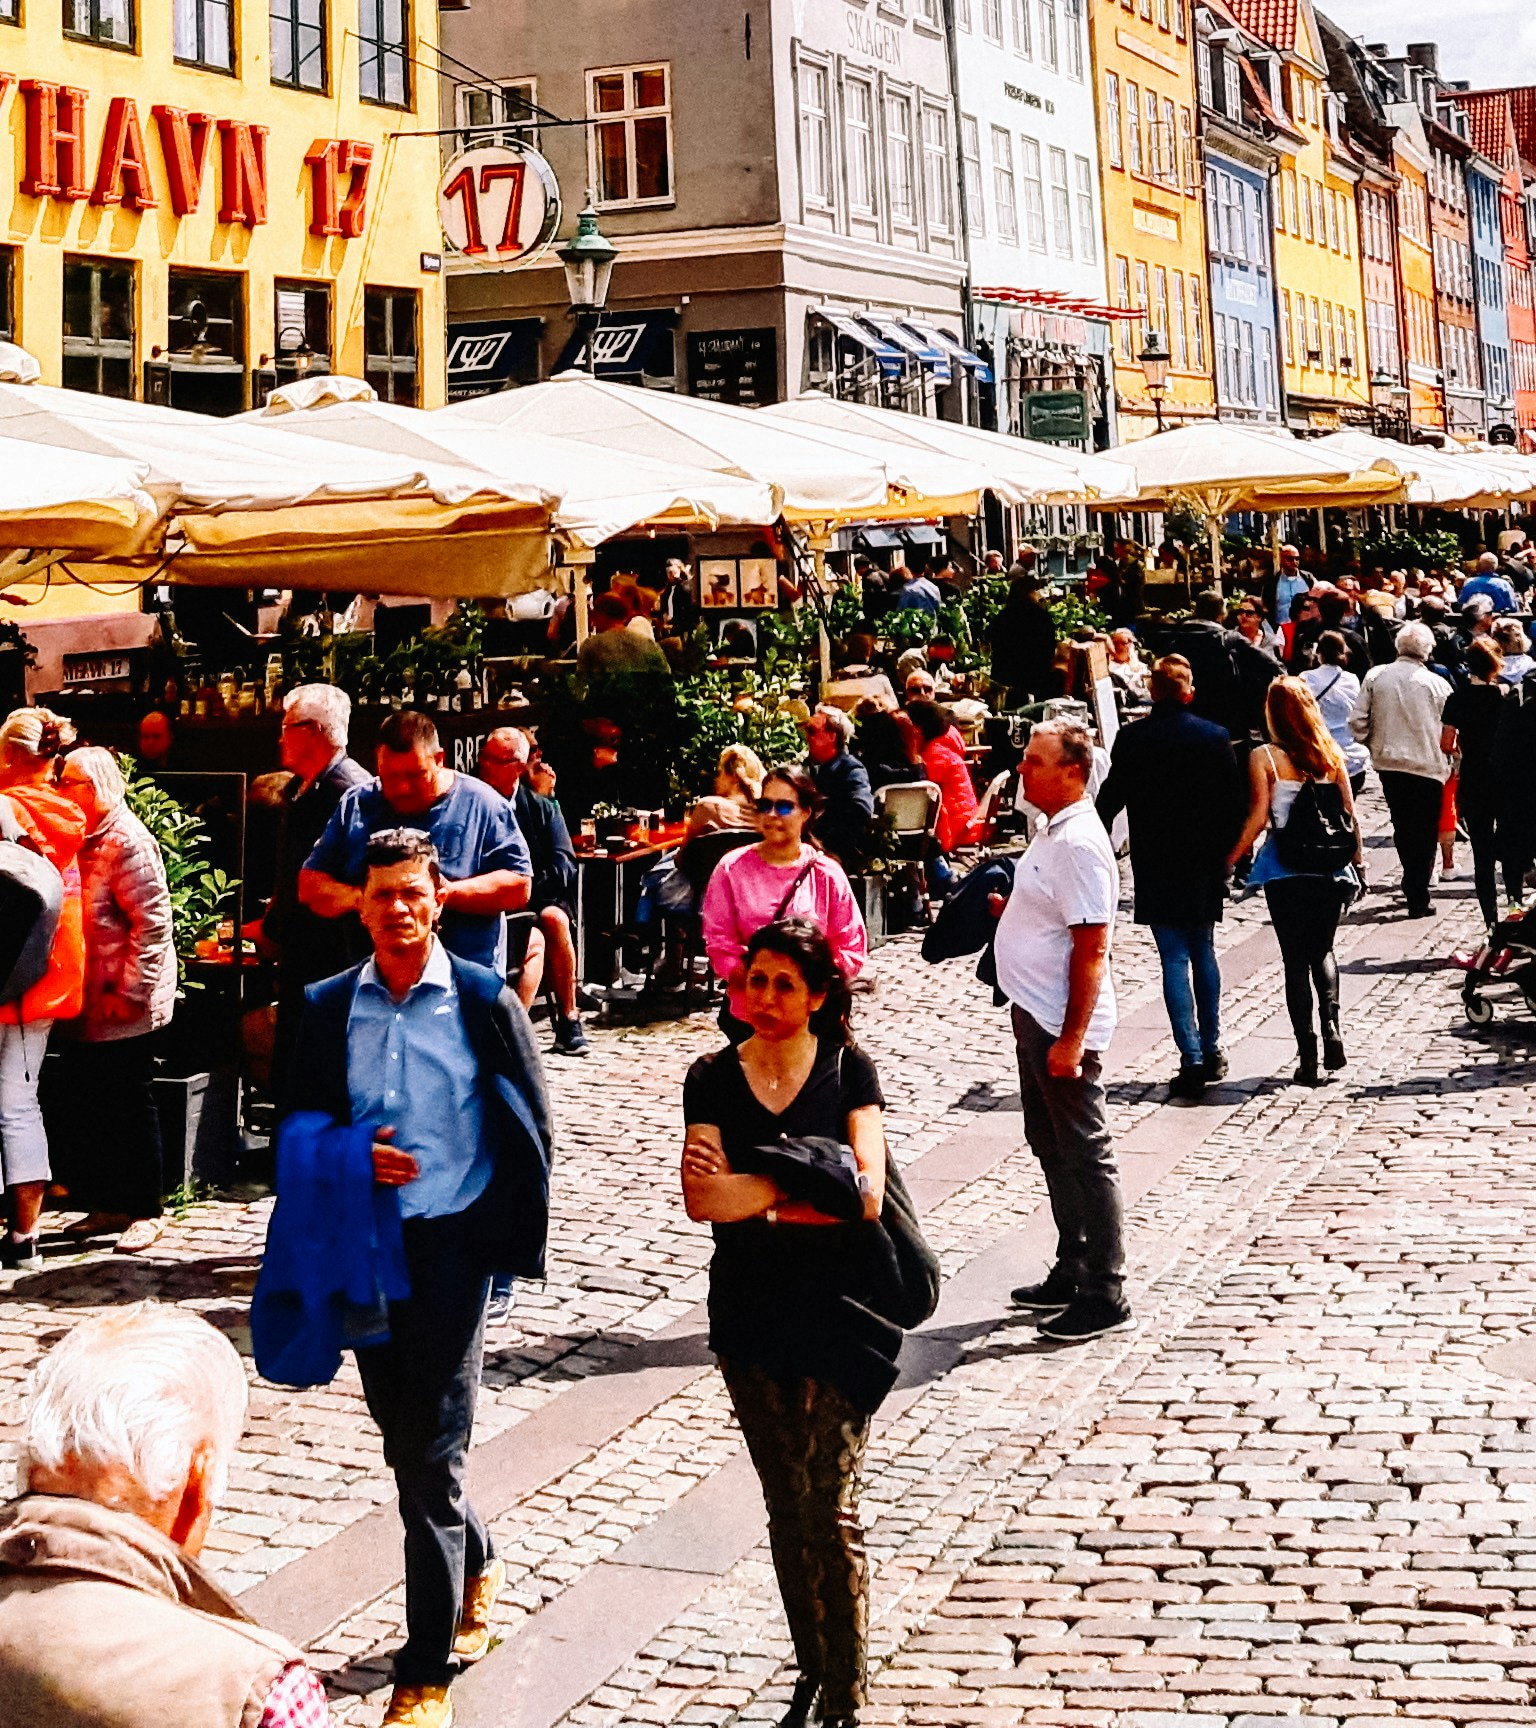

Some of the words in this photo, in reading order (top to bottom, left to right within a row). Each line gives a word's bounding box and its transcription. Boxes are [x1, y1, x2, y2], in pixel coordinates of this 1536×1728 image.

[846, 10, 902, 68] SKAGEN
[304, 138, 376, 240] 17
[443, 162, 527, 254] 17
